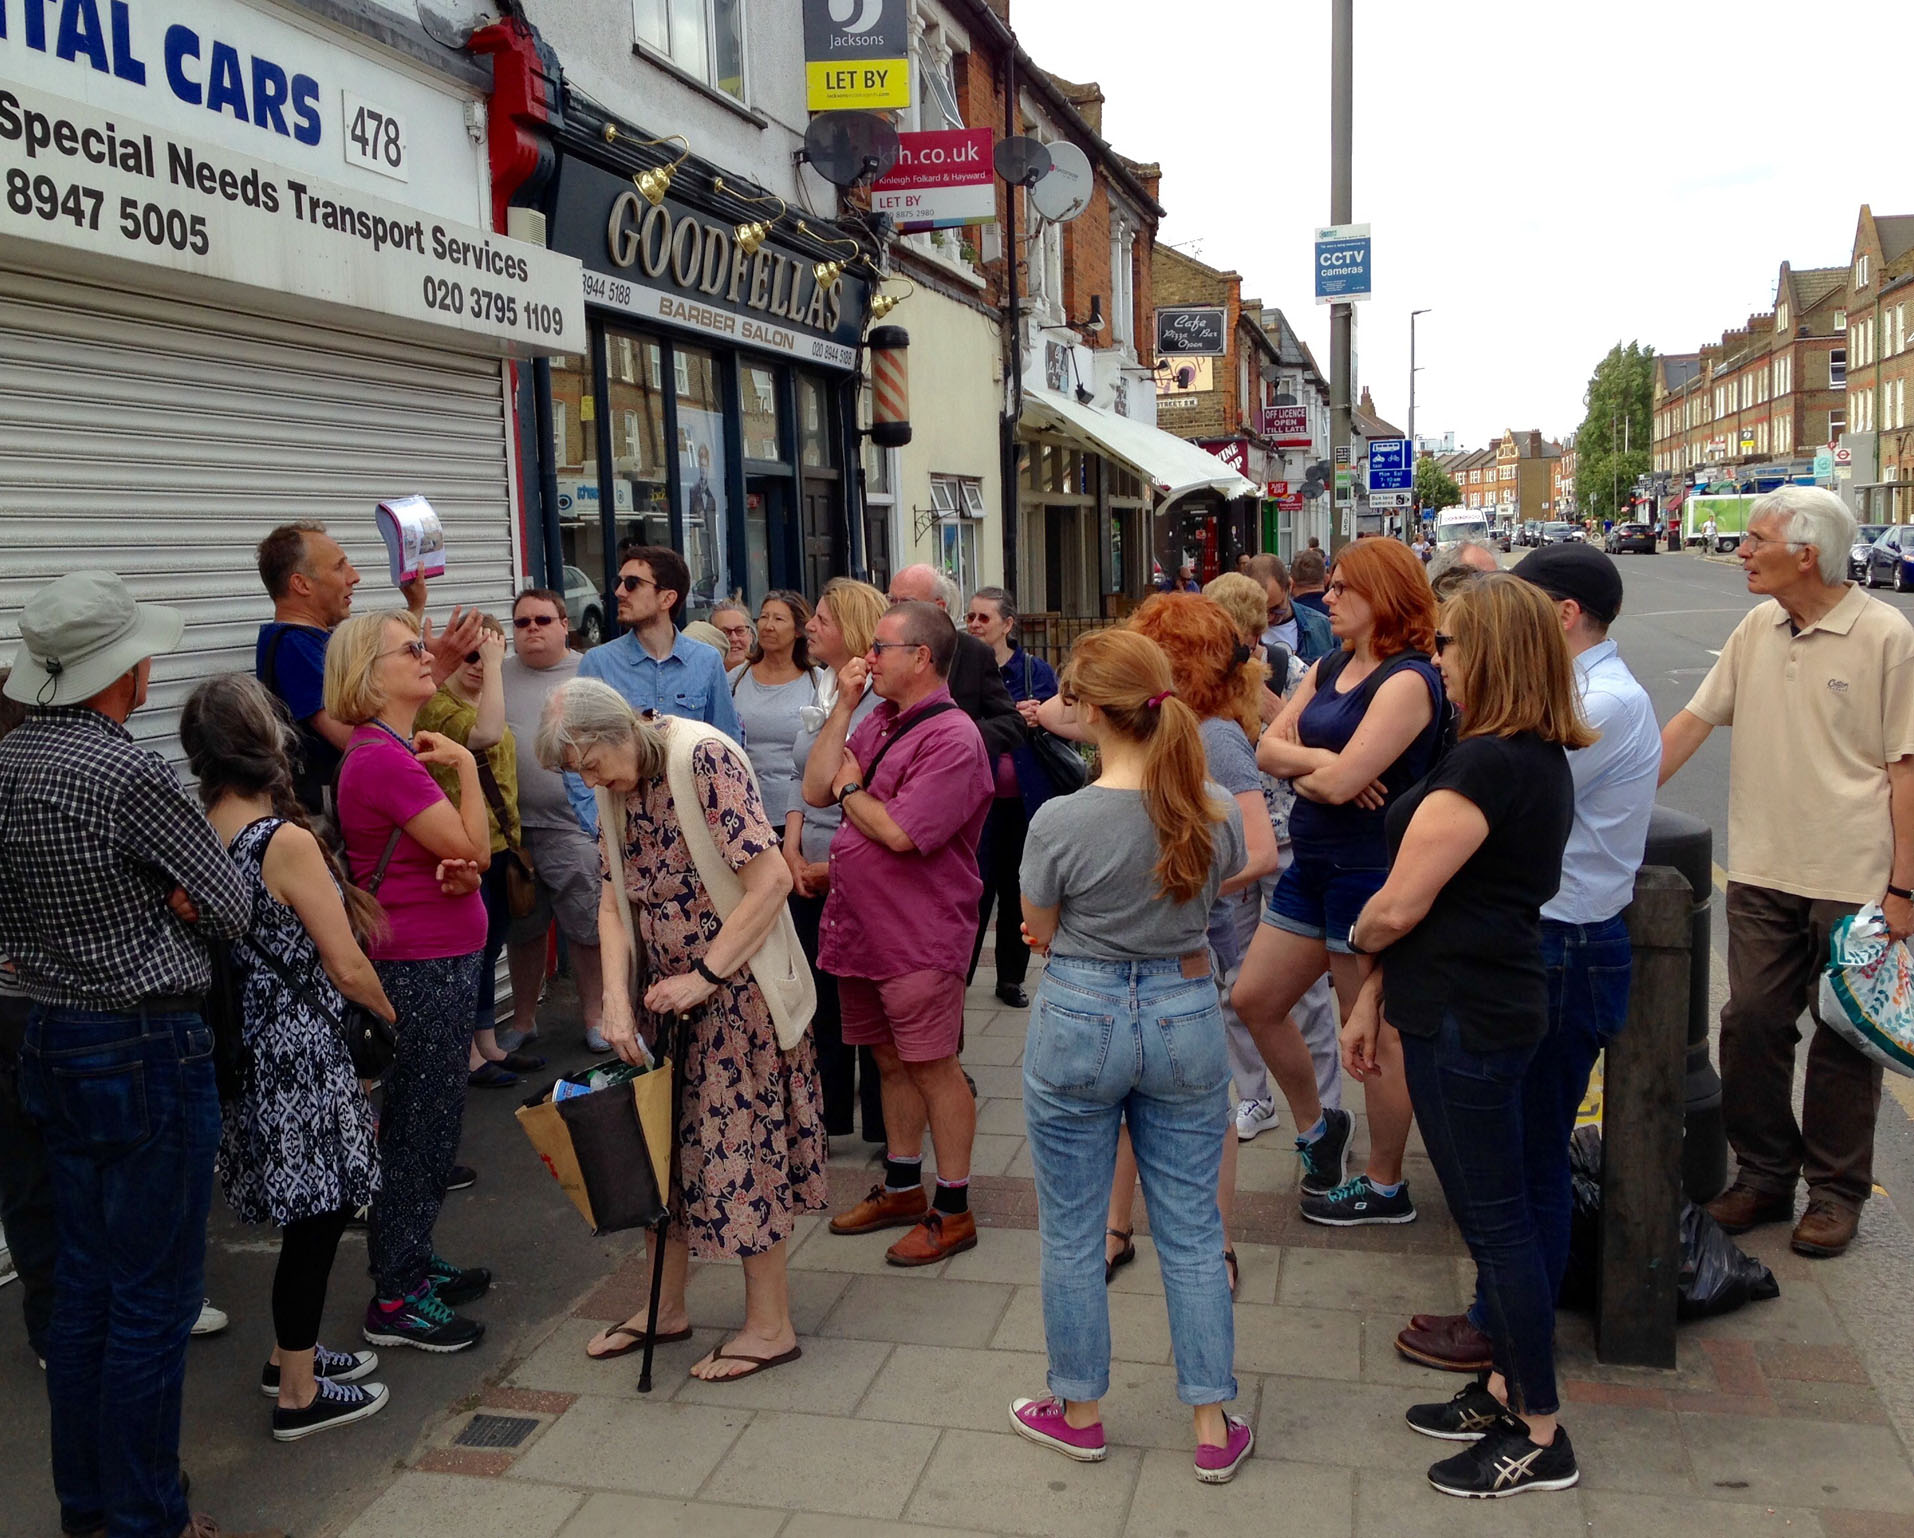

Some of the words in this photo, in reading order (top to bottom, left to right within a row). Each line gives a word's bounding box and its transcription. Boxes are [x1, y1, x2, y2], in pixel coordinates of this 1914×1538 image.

[829, 34, 884, 49] Jacksons
[0, 0, 146, 87] TAL
[164, 24, 322, 146] CARS
[826, 71, 857, 90] LET
[864, 70, 888, 88] BY
[350, 105, 402, 168] 478
[0, 90, 155, 178] Special
[168, 142, 280, 213] Needs
[287, 180, 425, 255] Transport
[432, 225, 528, 283] Services
[913, 173, 940, 184] Folkard
[943, 173, 949, 182] &
[952, 171, 985, 183] Hayward
[880, 197, 901, 209] LET
[906, 195, 920, 207] BY
[6, 168, 104, 231] 8947
[120, 196, 209, 256] 5005
[916, 208, 935, 217] 2980
[608, 191, 843, 333] GOODFELLAS
[1320, 249, 1364, 266] CCTV
[1321, 266, 1363, 277] cameras
[608, 281, 631, 305] 5188
[423, 275, 464, 314] 020
[470, 284, 518, 326] 3795
[523, 301, 563, 336] 1109
[659, 296, 736, 334] BARBER
[741, 320, 795, 350] SALON
[1199, 328, 1218, 338] Bar
[812, 341, 824, 357] 020
[825, 344, 838, 362] 8944
[1265, 408, 1278, 419] OFF
[1279, 407, 1306, 419] LICENCE
[1274, 418, 1297, 426] OPEN
[1285, 425, 1305, 433] LATE
